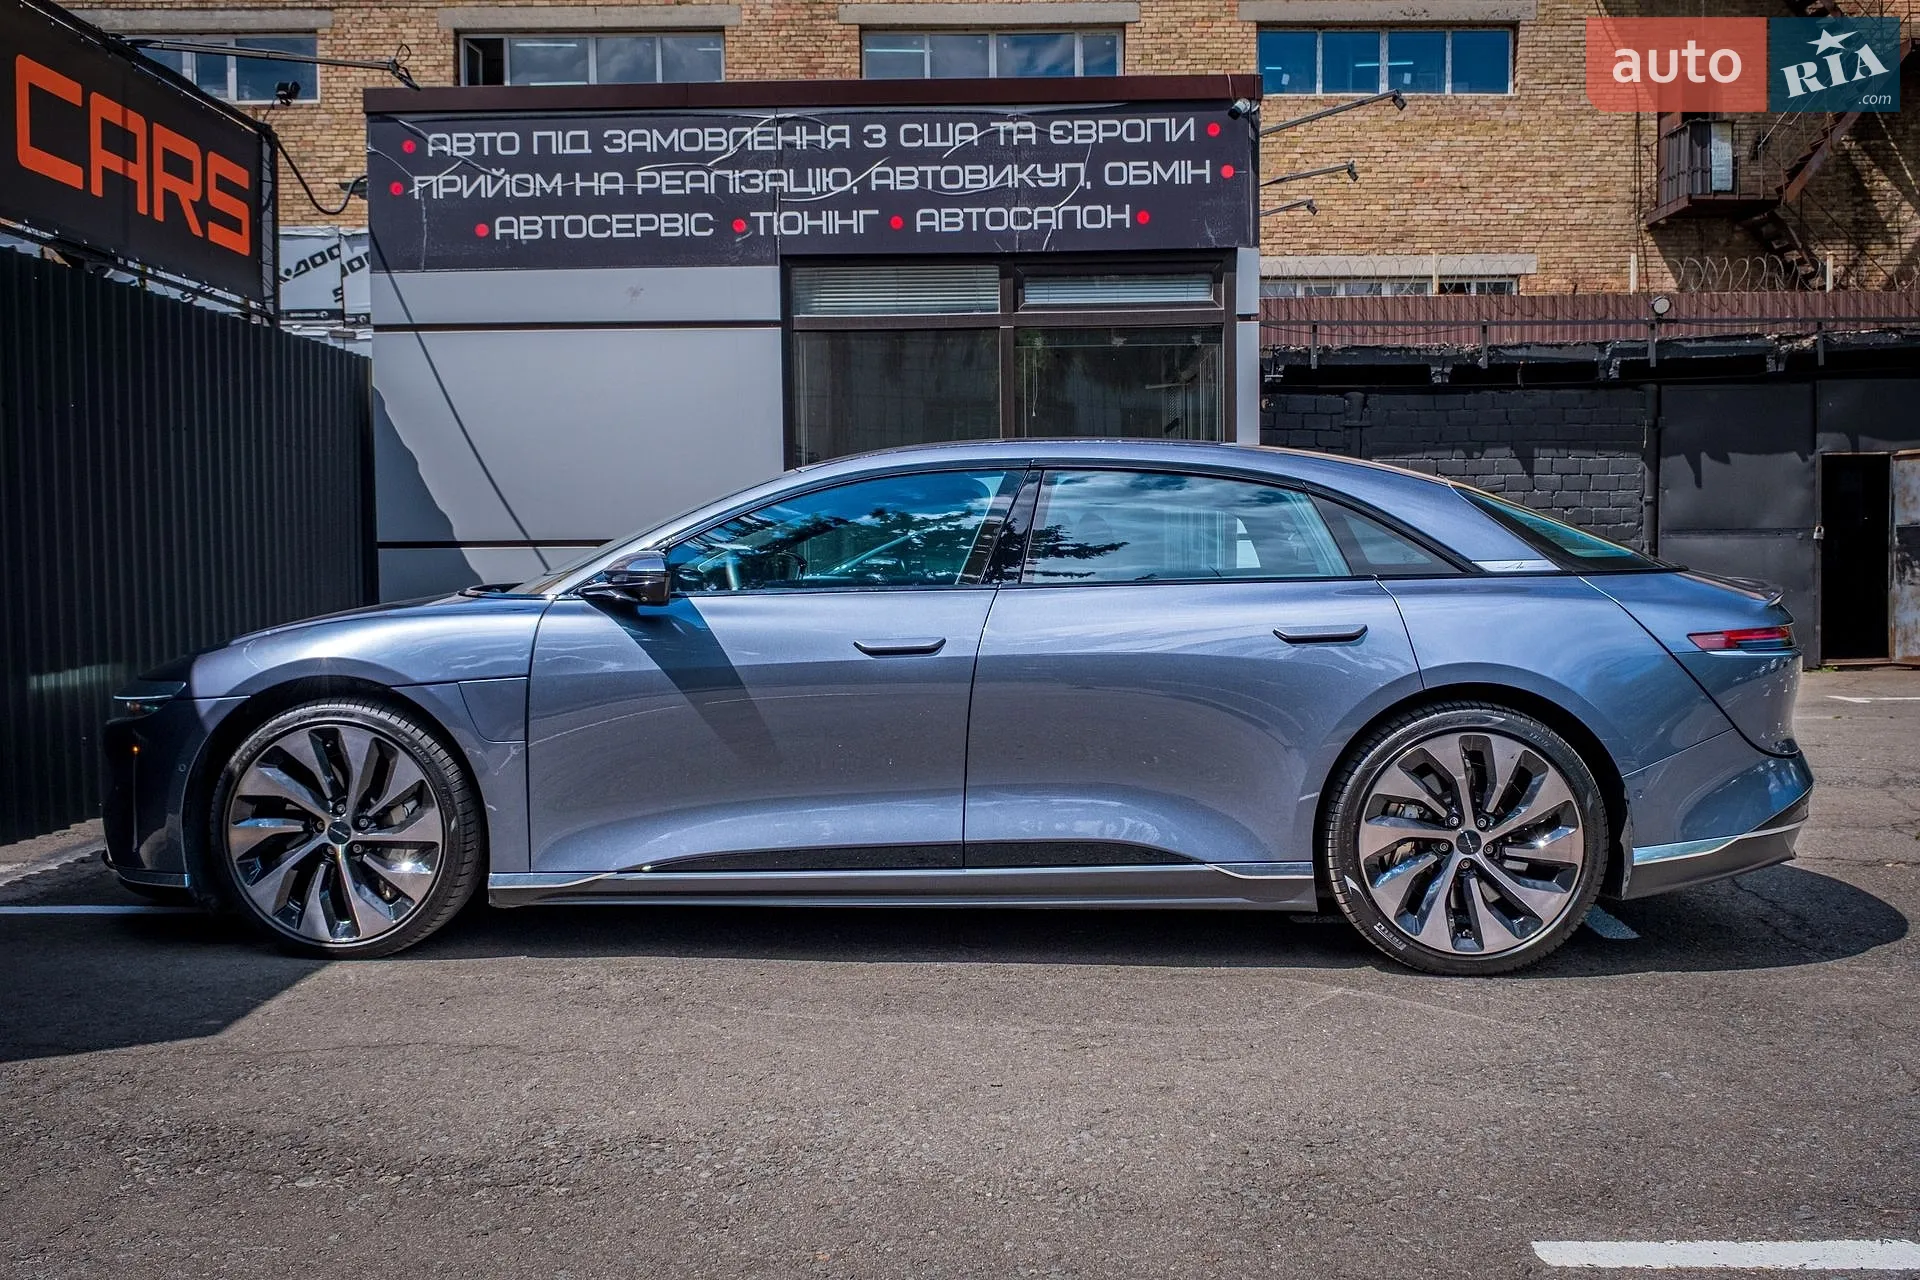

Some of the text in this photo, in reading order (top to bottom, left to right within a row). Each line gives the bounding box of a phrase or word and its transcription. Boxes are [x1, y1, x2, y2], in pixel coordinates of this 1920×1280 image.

[15, 54, 251, 257] CARS
[428, 118, 1195, 157] АВТО ПІД ЗАМОВЛЕННЯ З США ТА ЄВРОПИ
[413, 160, 1212, 200] ПРИЙОМ НА РЕАЛІЗАЦІЮ, АВТОВИКУП, ОБМІН
[494, 204, 1131, 240] АВТОСЕРВІС ТЮНІНГ АВТОСАЛОН
